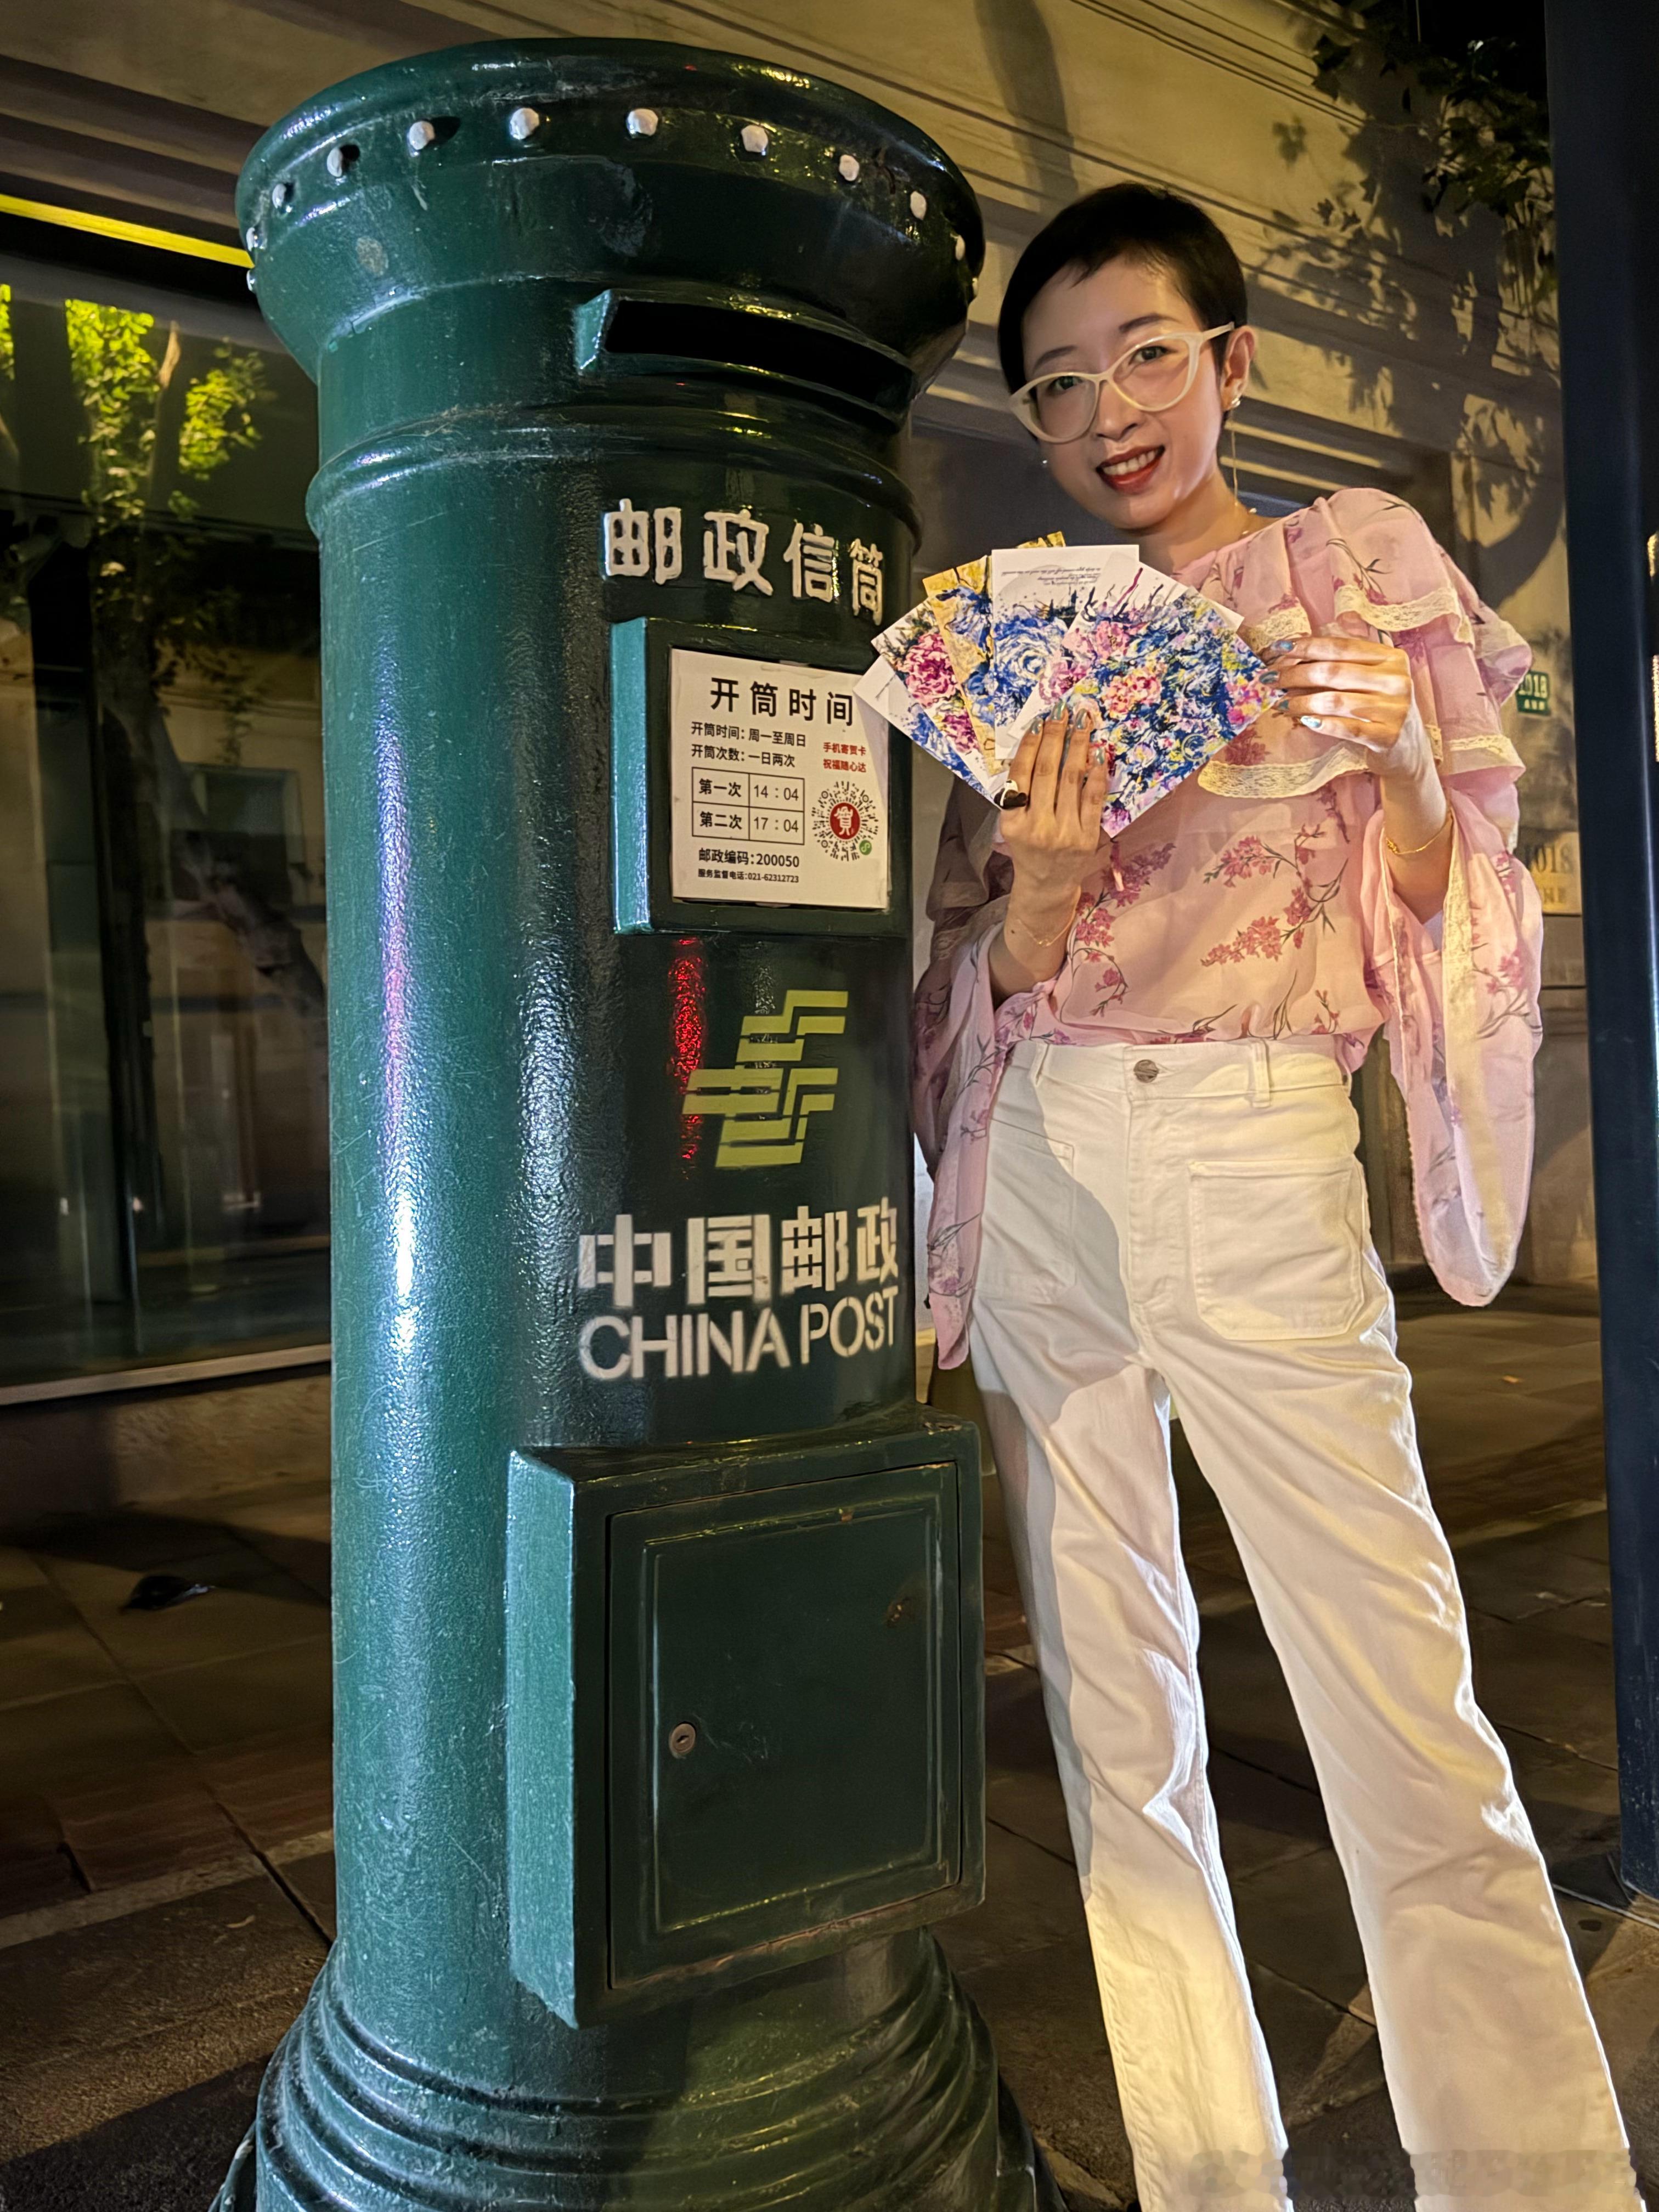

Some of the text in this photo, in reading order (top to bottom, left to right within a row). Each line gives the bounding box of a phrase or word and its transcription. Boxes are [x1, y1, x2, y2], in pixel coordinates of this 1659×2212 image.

[604, 498, 883, 625] 邮政信筒
[710, 677, 853, 726] 开筒时间
[691, 721, 806, 747] 开筒时间：周一至周日
[691, 744, 795, 768] 开筒次数：一日两次
[699, 778, 742, 798] 第一次
[699, 811, 742, 830] 第二次
[578, 1197, 898, 1308] 中国邮政
[579, 1286, 898, 1379] CHINA POST
